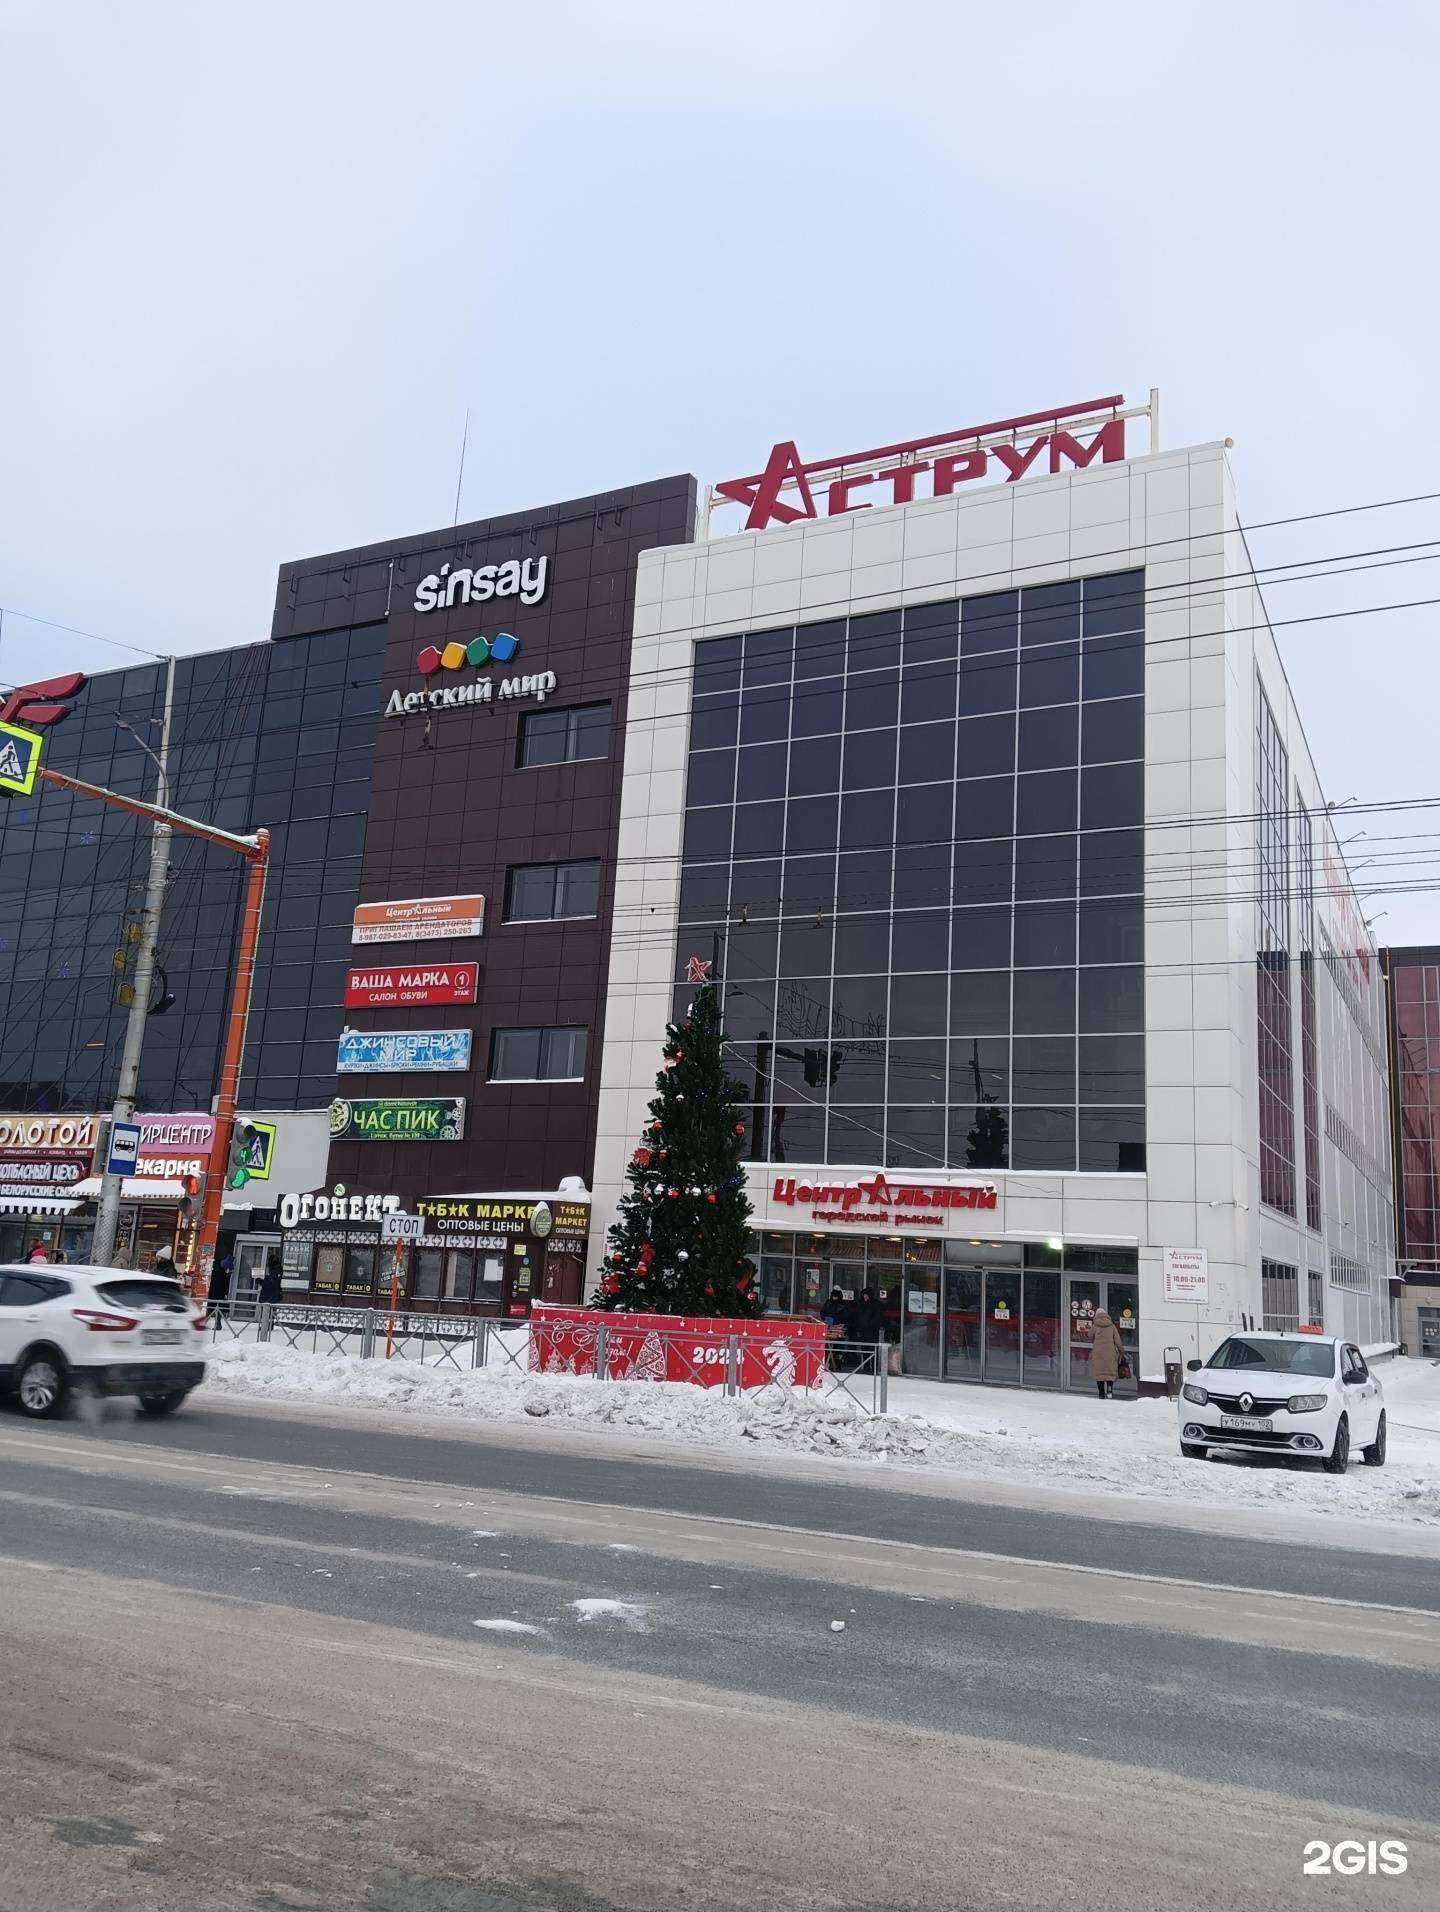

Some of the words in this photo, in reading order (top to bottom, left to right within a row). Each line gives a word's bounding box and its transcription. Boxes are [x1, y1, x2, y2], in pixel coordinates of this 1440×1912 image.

[414, 556, 548, 612] sinsay
[384, 677, 493, 717] Детский
[498, 671, 556, 702] мир
[360, 923, 413, 934] ПРИГЛАШАЕМ
[415, 920, 472, 930] АРЕНДАТОРОВ
[351, 974, 393, 989] ВАША
[399, 971, 449, 987] МАРКА
[458, 974, 465, 985] 1
[369, 992, 397, 1002] САЛОН
[400, 991, 428, 1000] ОБУВИ
[346, 1034, 456, 1049] ДЖИНСОВЫЙ
[379, 1048, 417, 1062] МИР
[353, 1110, 392, 1130] ЧАС
[396, 1110, 440, 1130] ПИК
[139, 1124, 213, 1144] ИРЦЕНТР
[53, 1164, 80, 1181] ЦЕХЪ
[135, 1158, 201, 1179] екарня
[476, 1204, 535, 1219] МАРКЕ
[811, 1210, 889, 1225] городской
[894, 1214, 945, 1227] рынок
[389, 1218, 419, 1234] СТОП
[437, 1219, 490, 1231] ОПТОВЫЕ
[492, 1220, 524, 1233] ЦЕНЫ
[555, 1217, 588, 1227] МАРКЕТ
